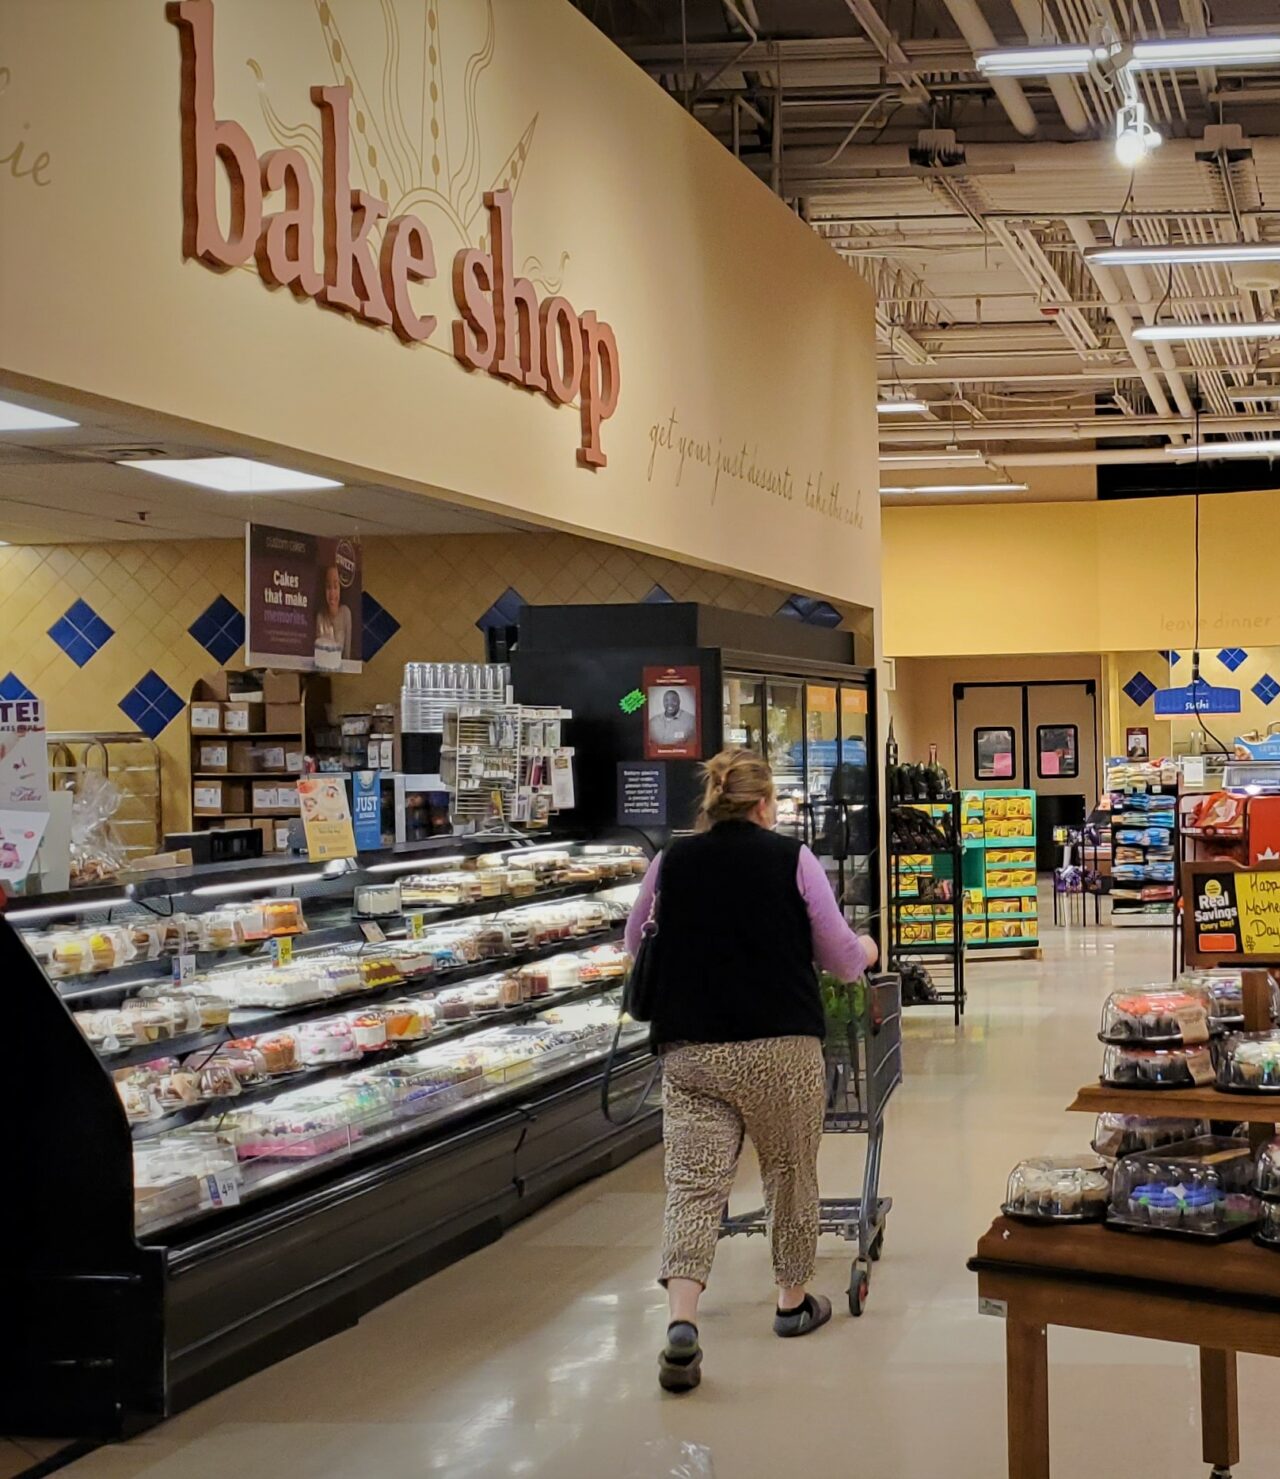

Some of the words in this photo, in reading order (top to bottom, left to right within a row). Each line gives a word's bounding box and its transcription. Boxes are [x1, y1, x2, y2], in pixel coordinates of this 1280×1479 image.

[165, 0, 437, 343] bake
[452, 188, 620, 468] shop
[648, 407, 678, 482] get
[677, 433, 711, 488] your
[712, 438, 749, 506] just
[747, 445, 793, 500] desserts
[273, 570, 299, 588] Cakes
[264, 588, 283, 605] that
[285, 592, 308, 608] make
[356, 796, 378, 812] JUST
[1199, 890, 1229, 909] Real
[1195, 907, 1237, 922] Savings
